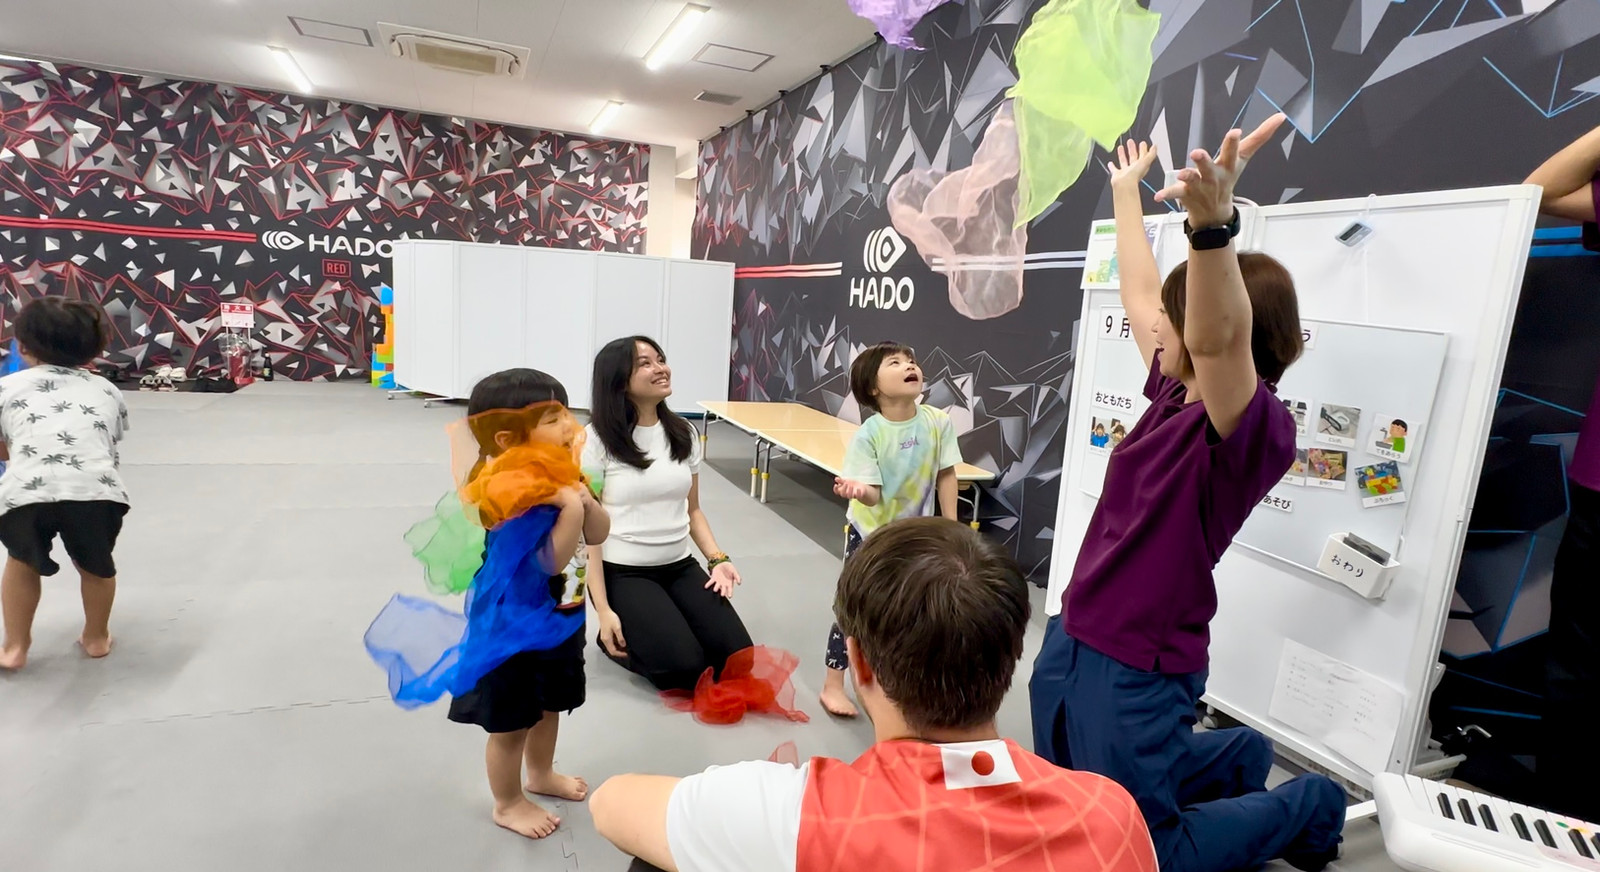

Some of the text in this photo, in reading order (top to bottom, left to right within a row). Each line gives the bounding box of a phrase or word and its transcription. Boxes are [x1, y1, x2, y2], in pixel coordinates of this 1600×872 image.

[309, 233, 394, 258] HADO
[327, 263, 347, 275] RED
[849, 276, 915, 311] HADO
[1095, 392, 1132, 409] おともだち
[1263, 495, 1292, 509] あそび
[1331, 554, 1364, 578] おわり
